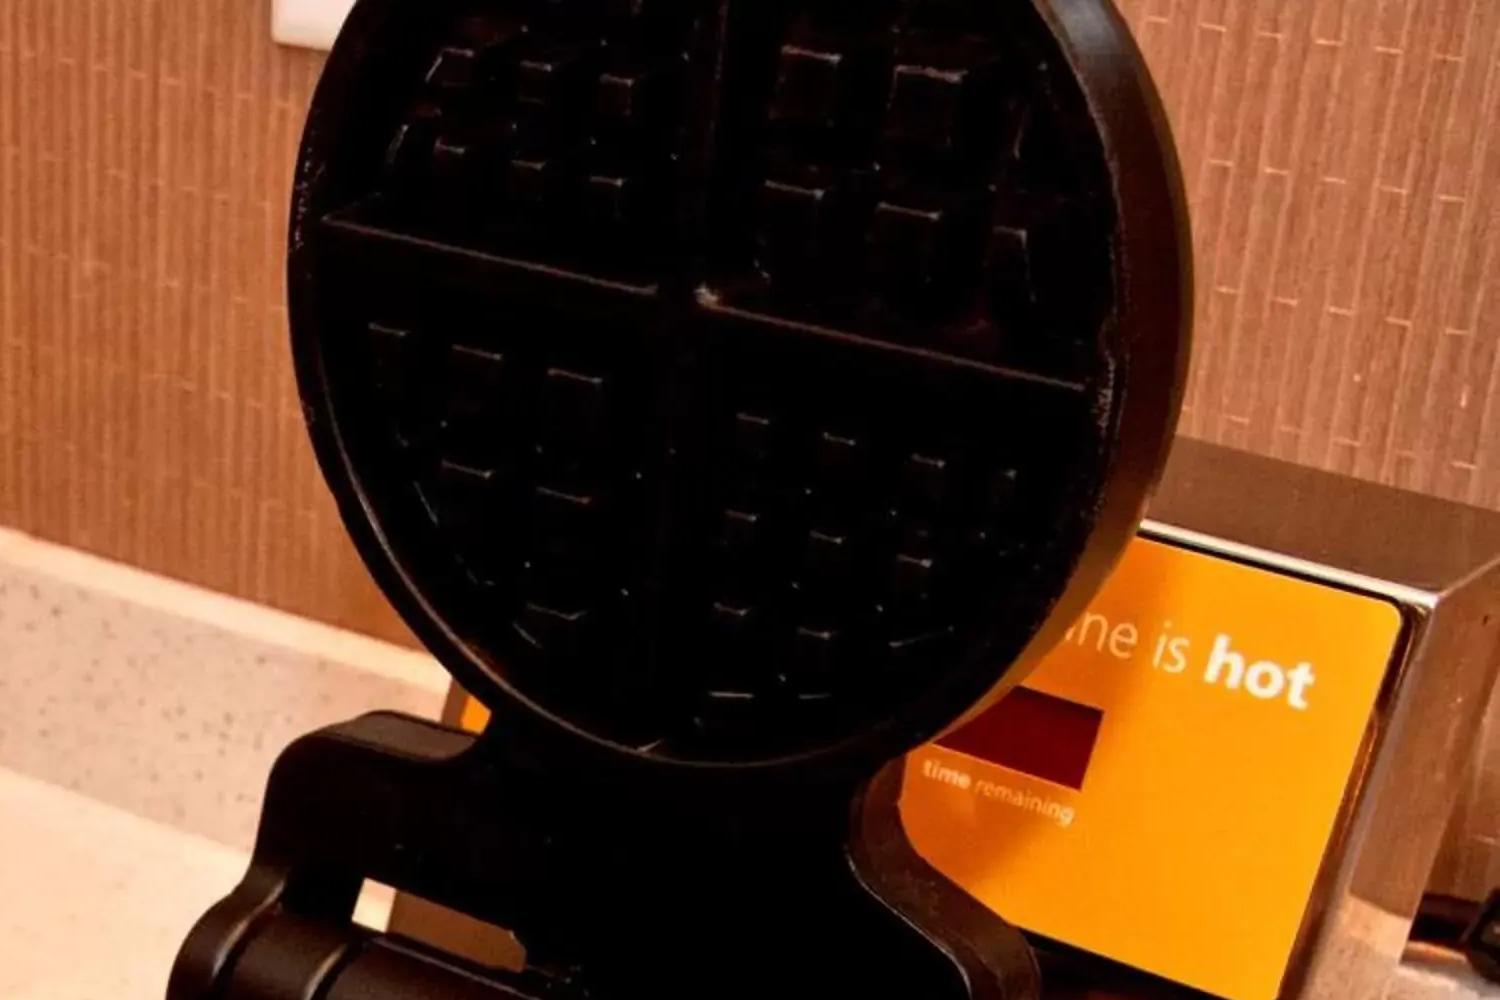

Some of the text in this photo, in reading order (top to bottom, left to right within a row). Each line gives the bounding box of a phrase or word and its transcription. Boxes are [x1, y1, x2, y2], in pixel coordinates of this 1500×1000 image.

[1152, 619, 1190, 674] is
[1203, 632, 1316, 711] hot
[922, 759, 1076, 828] time remaining
